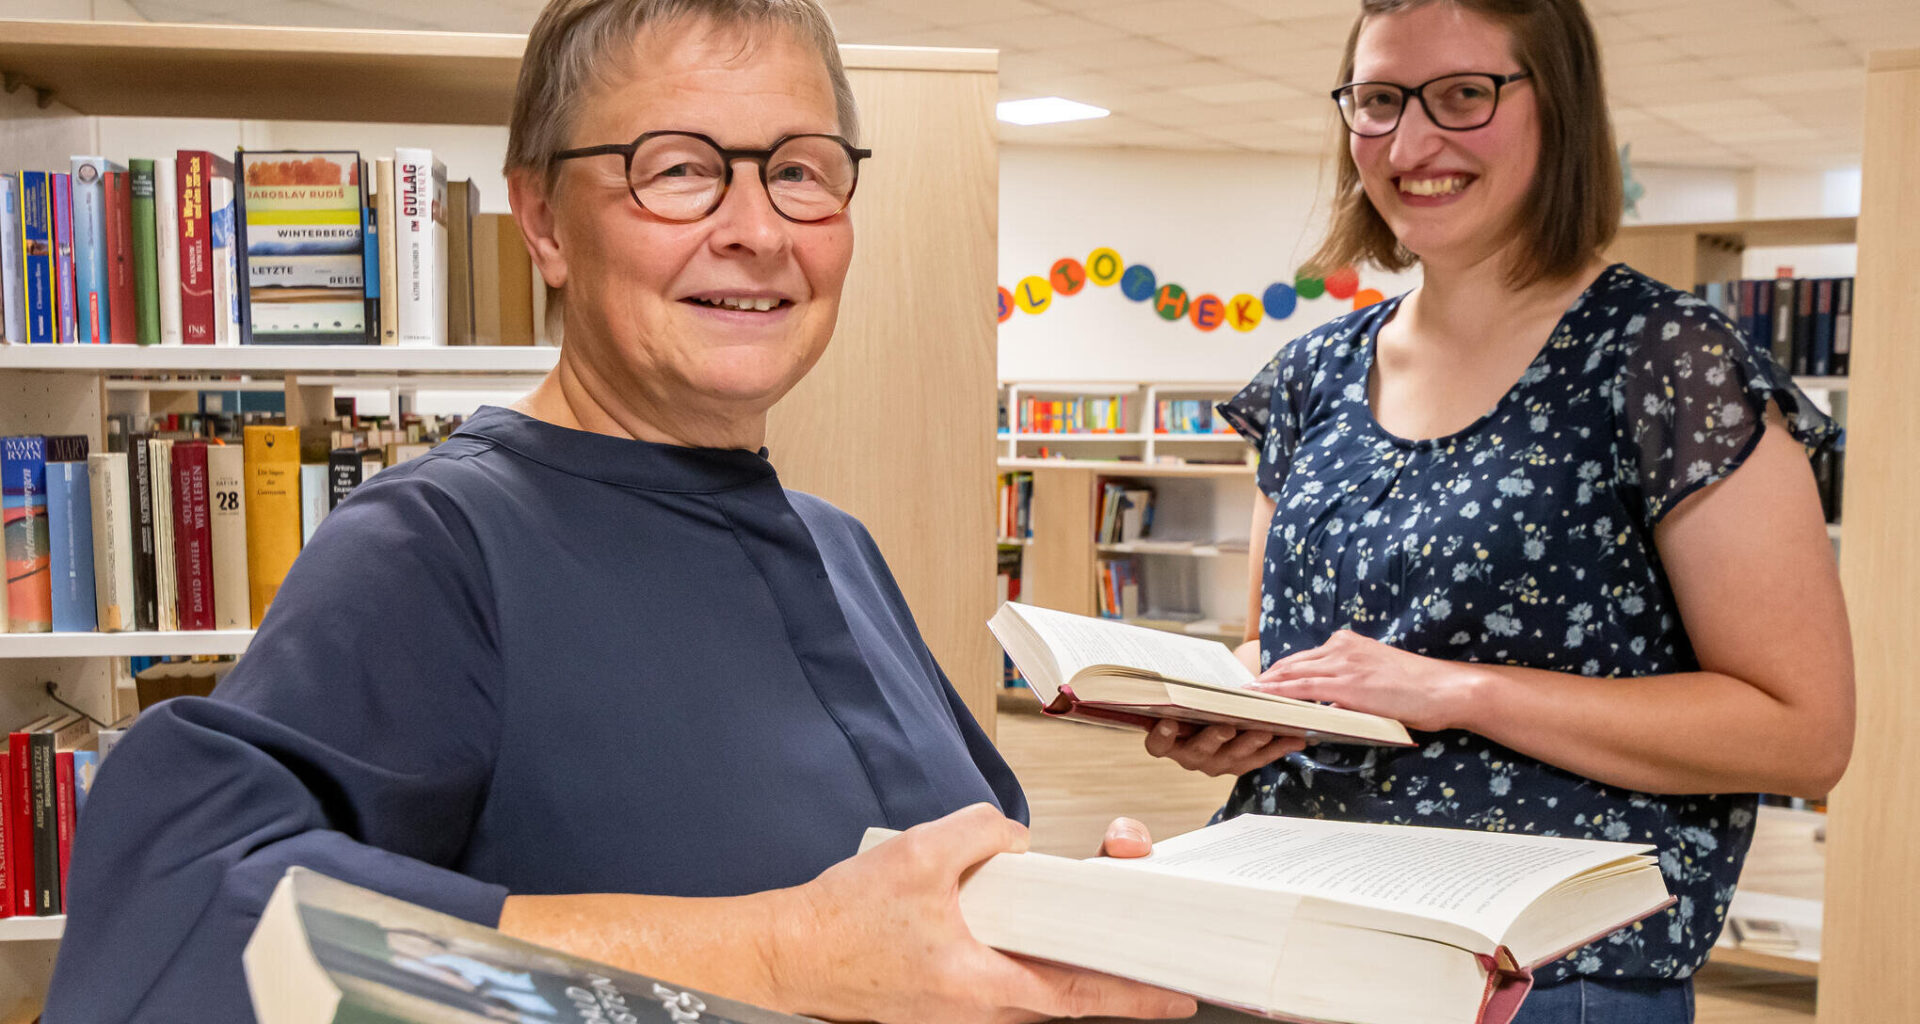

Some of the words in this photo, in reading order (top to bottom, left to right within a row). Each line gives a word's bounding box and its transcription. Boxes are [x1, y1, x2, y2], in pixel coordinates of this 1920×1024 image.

[248, 191, 308, 200] JAROSLAV
[310, 188, 344, 199] RUDIŠ
[403, 164, 417, 216] GULAG
[277, 229, 361, 239] WINTERBERGS
[252, 266, 293, 275] LETZTE
[330, 276, 363, 285] REISE
[188, 325, 206, 335] INK
[6, 440, 42, 451] MARY
[7, 449, 42, 460] RYAN
[55, 439, 87, 460] MARY
[192, 465, 203, 500] LEBEN
[181, 469, 192, 524] SOLANGE
[216, 492, 239, 511] 28
[20, 468, 36, 570] Septembermorgen
[194, 505, 204, 528] WIR
[191, 541, 201, 576] SAFIER
[193, 579, 203, 612] DAVID
[34, 746, 43, 790] SAWATZKI
[36, 791, 45, 828] ANDREA
